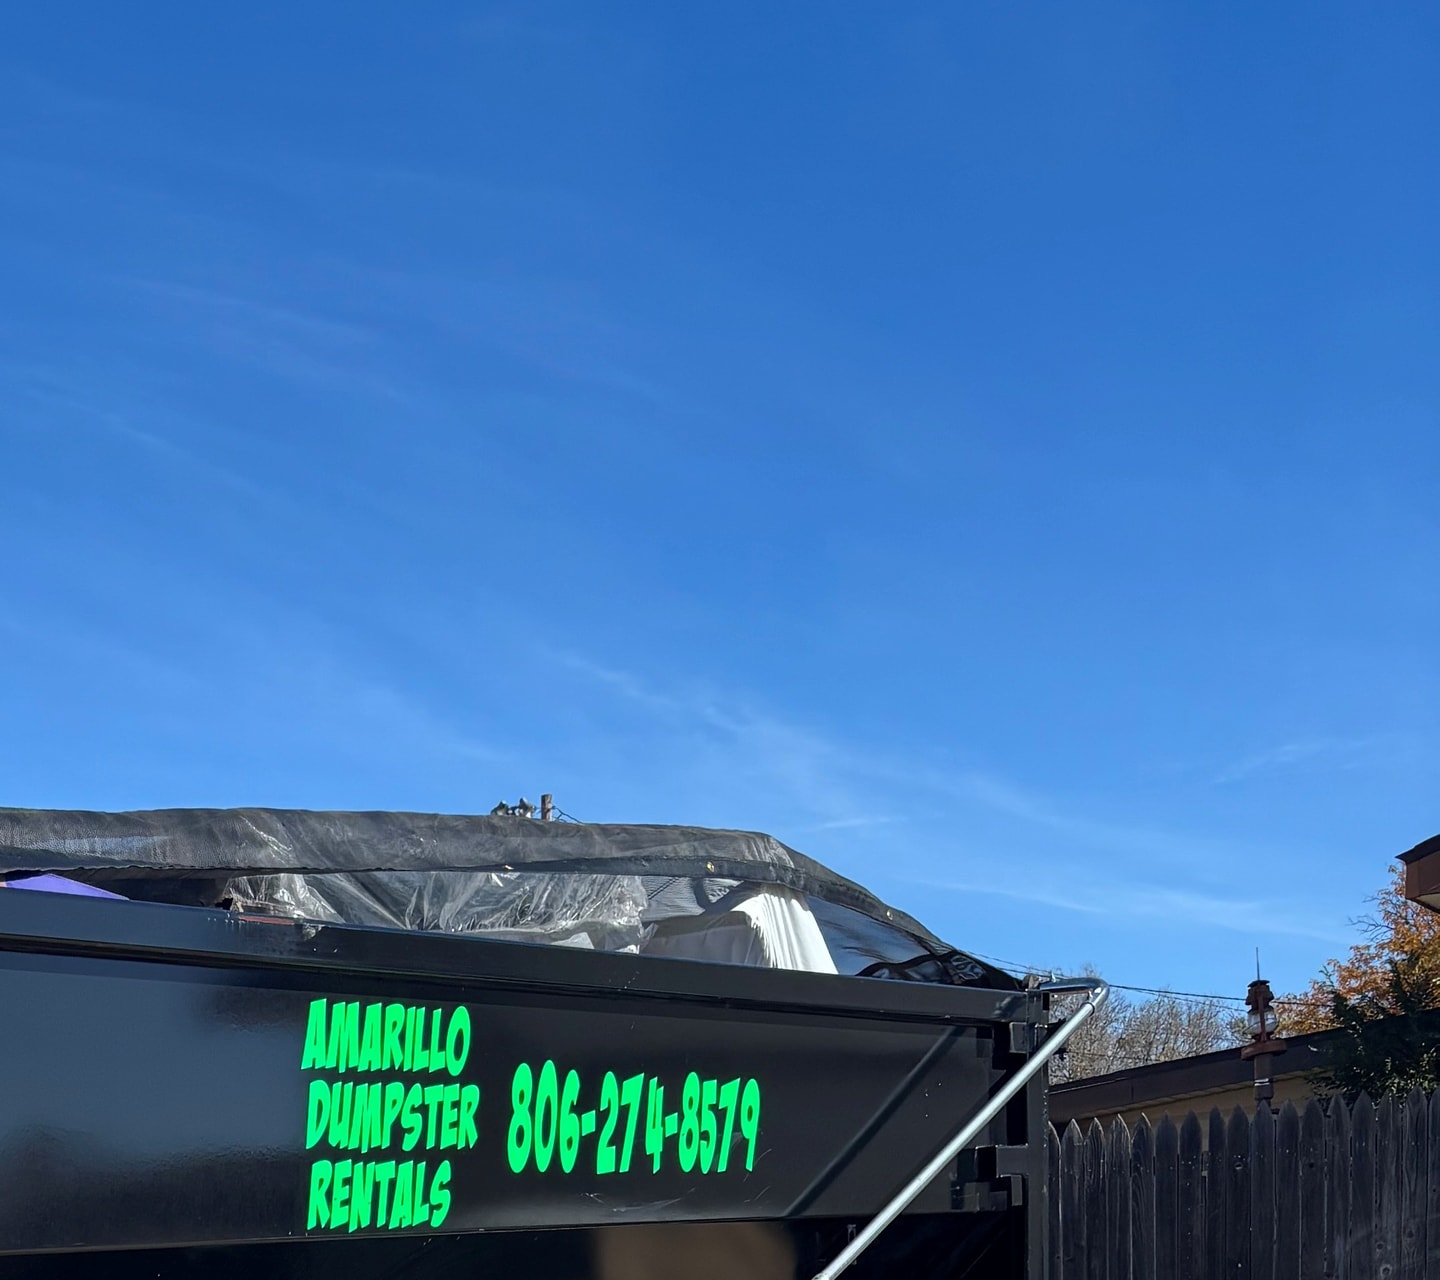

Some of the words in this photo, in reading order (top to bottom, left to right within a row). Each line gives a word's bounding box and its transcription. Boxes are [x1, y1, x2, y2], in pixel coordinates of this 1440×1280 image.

[301, 998, 471, 1077] AMARILLO
[306, 1079, 480, 1153] DUMPSTER
[507, 1060, 761, 1175] 806-274-8579
[307, 1159, 451, 1234] RENTALS
